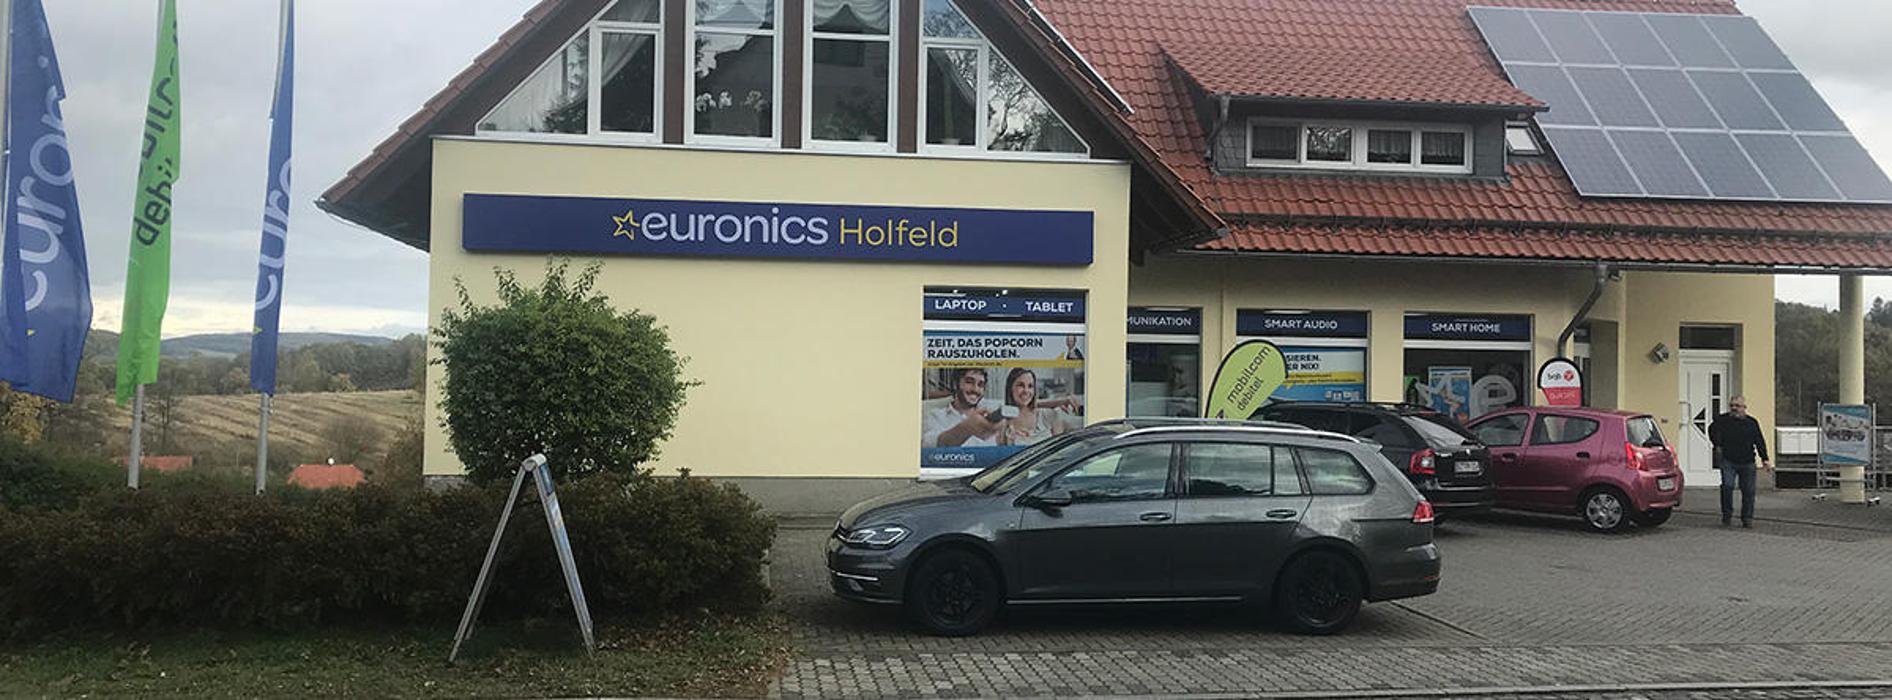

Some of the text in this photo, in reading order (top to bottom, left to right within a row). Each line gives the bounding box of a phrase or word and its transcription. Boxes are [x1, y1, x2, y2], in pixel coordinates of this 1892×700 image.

[641, 207, 958, 247] euronics Holfeld
[935, 299, 1074, 313] LAPTOP TABLET
[1264, 319, 1338, 329] SMART AUDIO
[1431, 322, 1501, 333] SMART HOME
[927, 338, 1043, 349] ZEIT, DAS POPCORN
[927, 349, 1021, 359] RAUSZUHOLEN.
[1237, 376, 1264, 411] debitel
